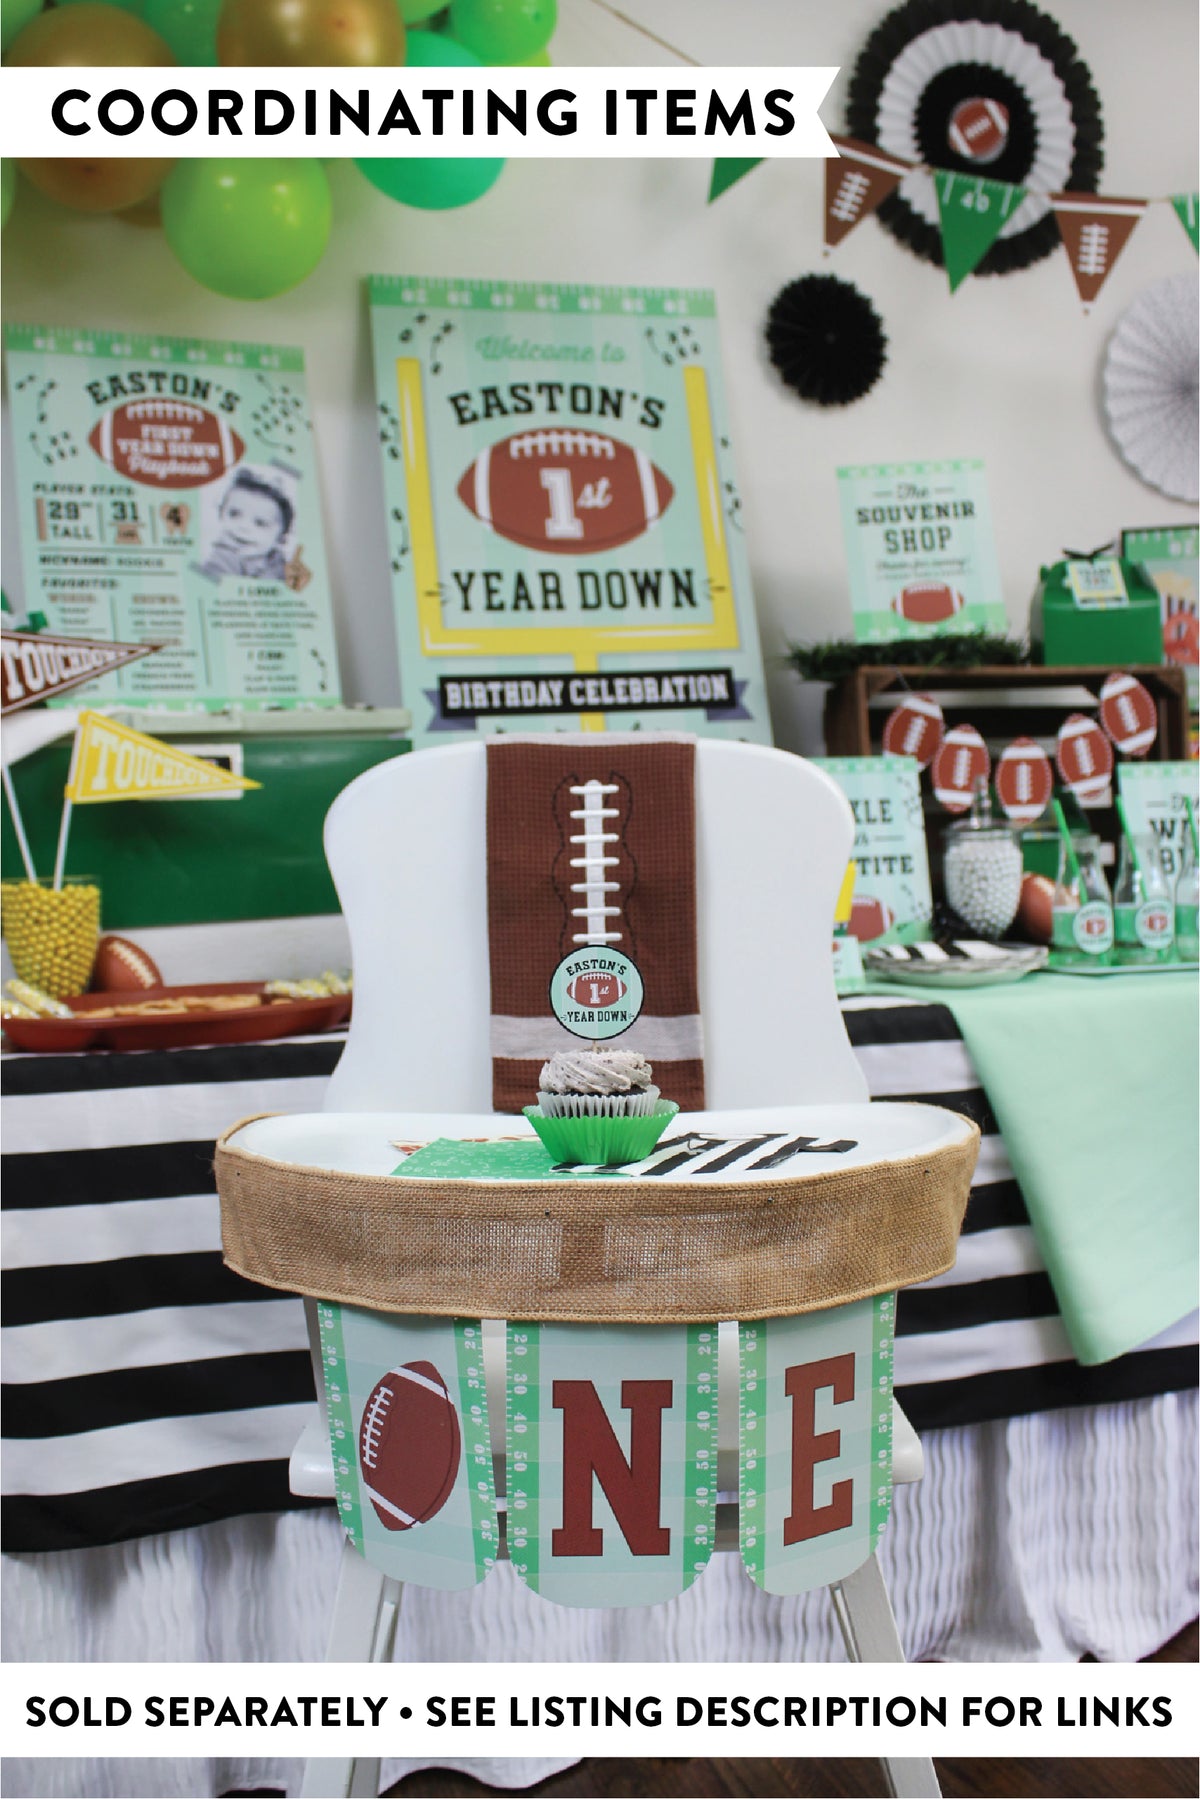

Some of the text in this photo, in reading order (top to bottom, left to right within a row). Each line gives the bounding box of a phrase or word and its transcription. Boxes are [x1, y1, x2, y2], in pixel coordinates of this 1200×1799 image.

[475, 336, 626, 363] Welcome to
[86, 370, 241, 413] EASTON'S
[449, 381, 666, 429] EASTON'S
[141, 424, 193, 442] FIRST
[117, 438, 220, 459] YEAR DOWN
[127, 454, 210, 480] Playbook
[896, 482, 929, 500] The
[112, 501, 139, 521] 31
[540, 467, 613, 540] 1st
[856, 500, 975, 526] SOUVENIR
[167, 506, 181, 526] 4
[52, 524, 92, 540] TALL
[885, 525, 953, 554] SHOP
[452, 568, 698, 611] YEAR DOWN
[444, 673, 730, 709] BIRTHDAY CELEBRATION
[566, 958, 627, 976] EASTON'S
[567, 1010, 628, 1023] YEAR DOWN
[323, 1309, 334, 1330] 20
[879, 1301, 890, 1323] 20
[464, 1326, 477, 1350] 20
[513, 1334, 528, 1356] 20
[697, 1332, 712, 1356] 20
[745, 1329, 757, 1351] 20
[326, 1345, 338, 1367] 30
[879, 1339, 889, 1360] 30
[466, 1366, 480, 1389] 30
[513, 1373, 528, 1395] 30
[696, 1372, 711, 1394] 30
[745, 1369, 757, 1391] 30
[879, 1375, 888, 1396] 40
[330, 1382, 342, 1403] 40
[470, 1405, 483, 1426] 40
[513, 1412, 528, 1434] 40
[696, 1410, 711, 1432] 40
[745, 1409, 757, 1430] 40
[878, 1413, 888, 1434] 50
[334, 1418, 346, 1440] 50
[473, 1443, 487, 1466] 50
[695, 1449, 710, 1470] 50
[745, 1448, 757, 1470] 50
[784, 1351, 856, 1547] E
[877, 1449, 887, 1469] 40
[338, 1456, 349, 1476] 40
[513, 1450, 528, 1472] 50
[552, 1379, 673, 1557] N
[341, 1491, 353, 1512] 30
[477, 1481, 490, 1503] 40
[513, 1488, 528, 1510] 40
[695, 1487, 709, 1509] 40
[745, 1487, 757, 1509] 40
[877, 1485, 887, 1507] 30
[480, 1519, 493, 1541] 30
[513, 1526, 528, 1548] 30
[694, 1524, 708, 1546] 30
[745, 1525, 757, 1547] 30
